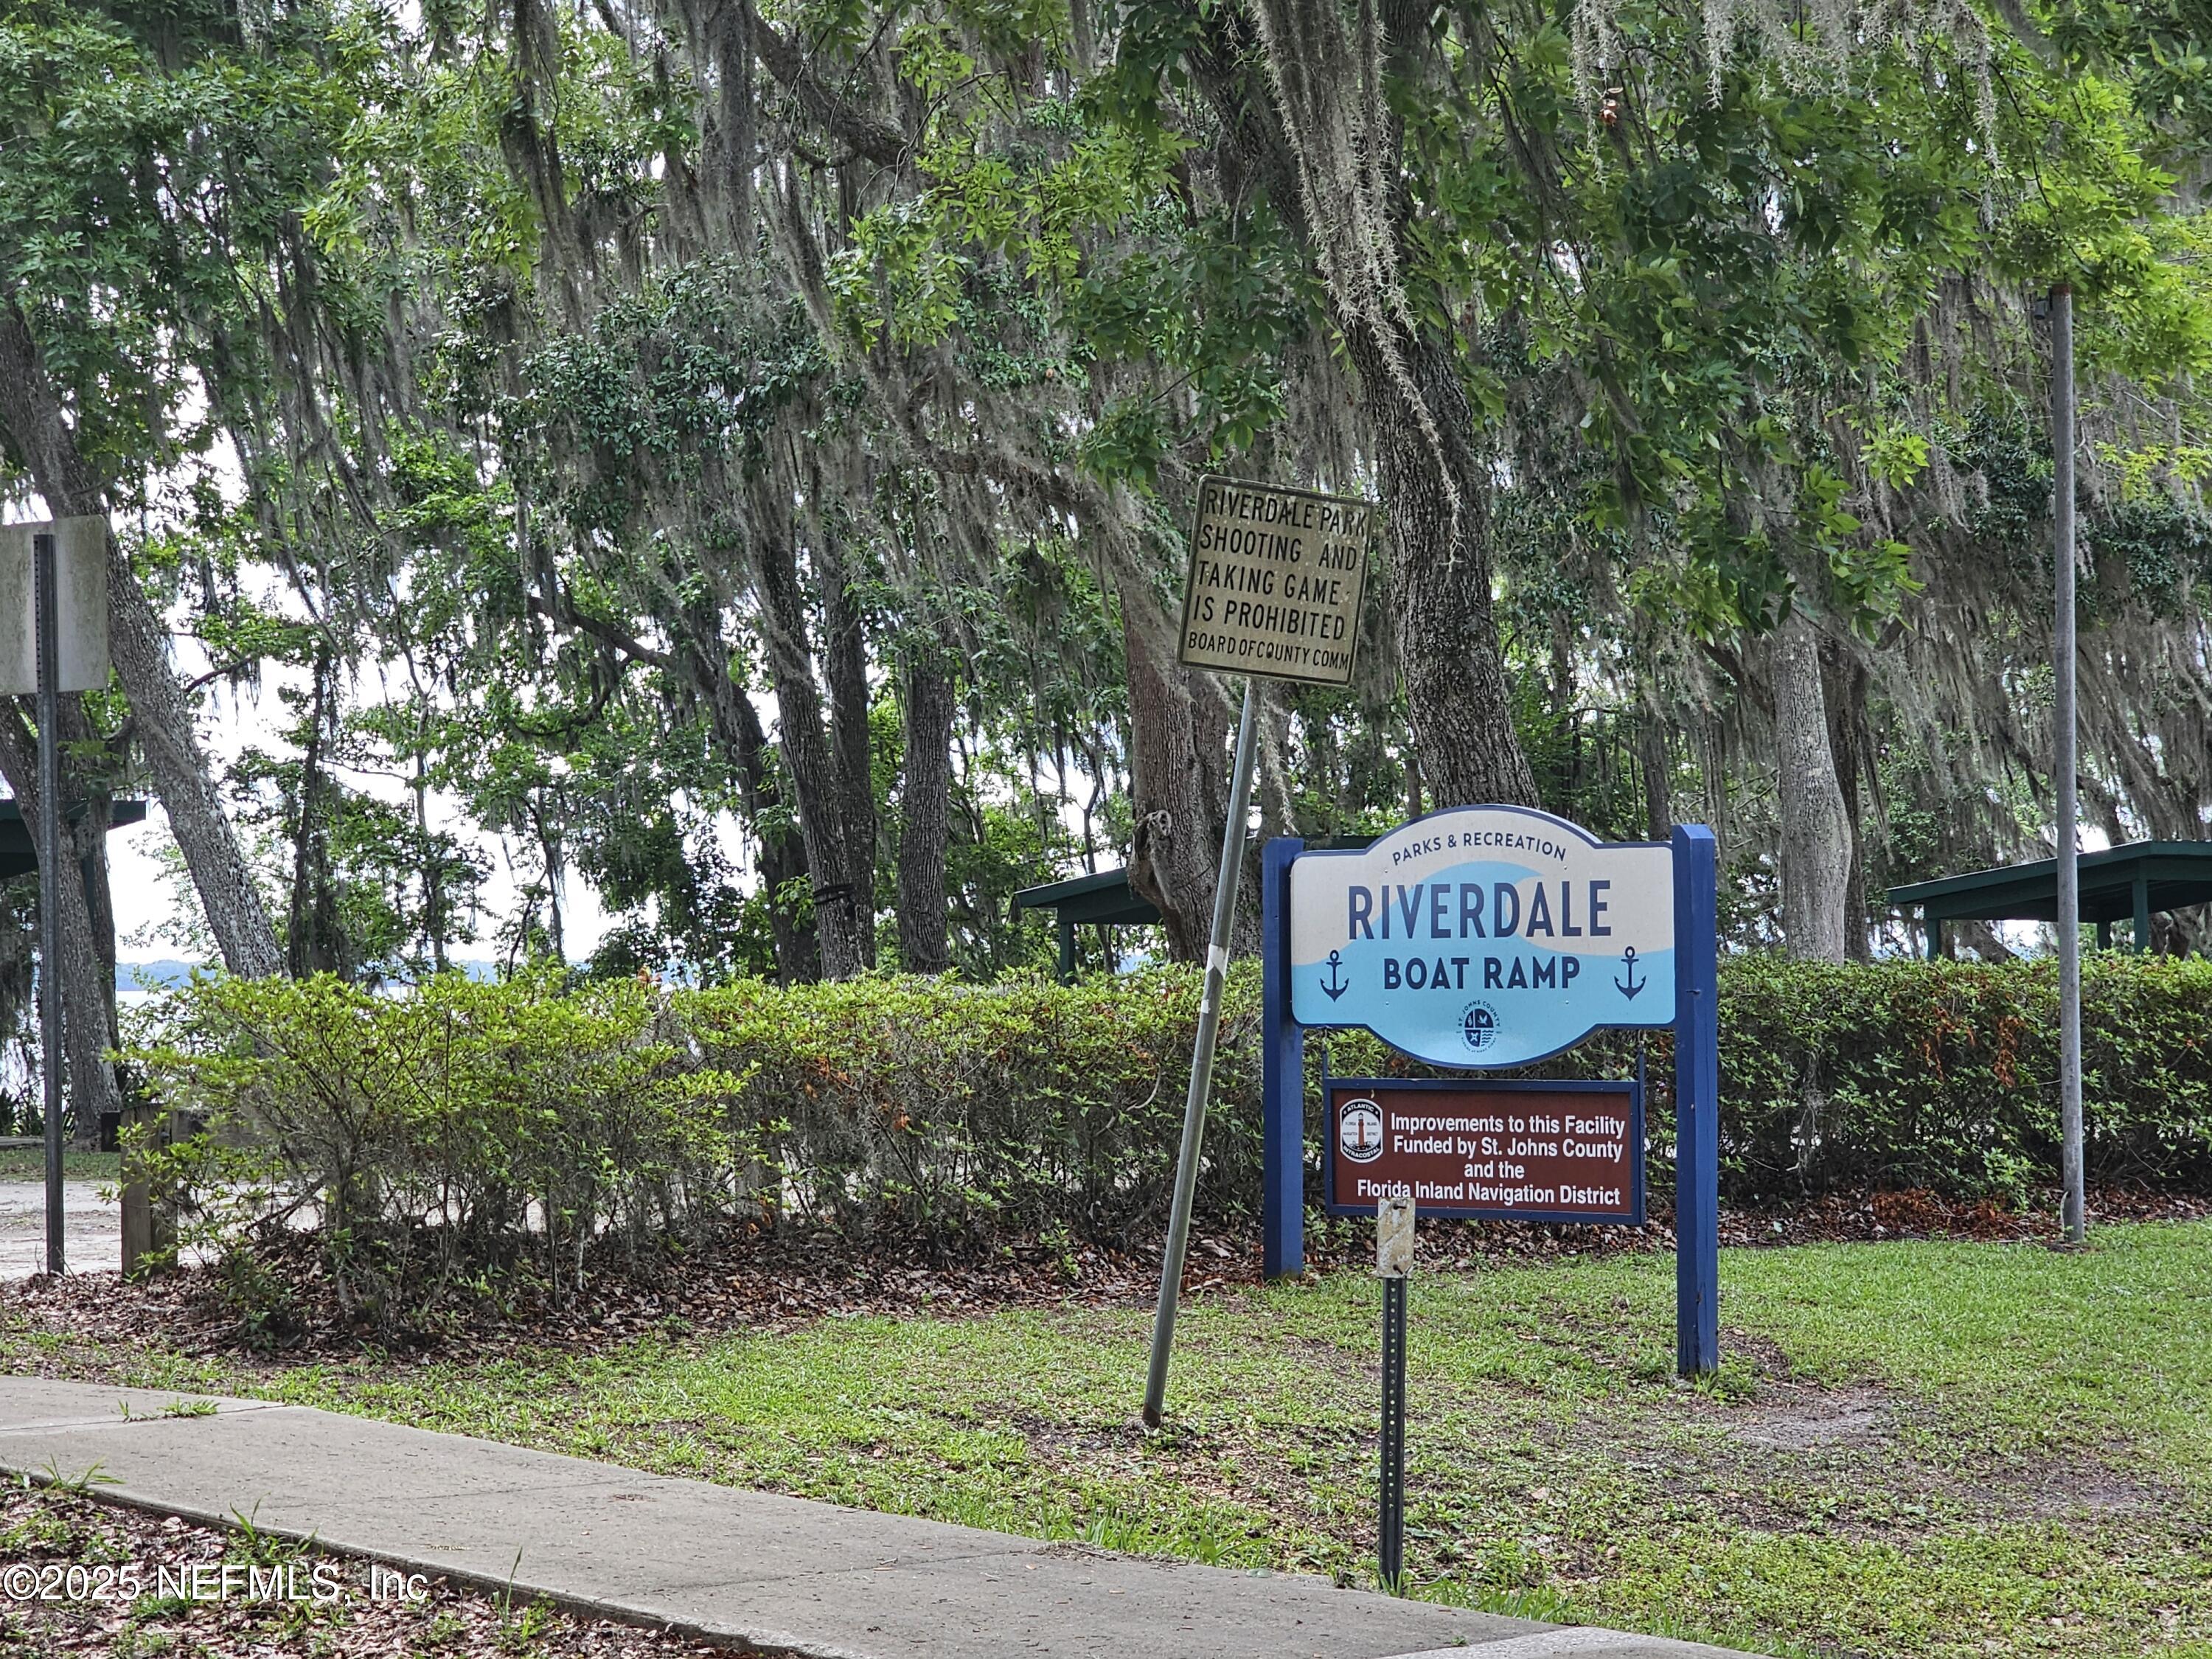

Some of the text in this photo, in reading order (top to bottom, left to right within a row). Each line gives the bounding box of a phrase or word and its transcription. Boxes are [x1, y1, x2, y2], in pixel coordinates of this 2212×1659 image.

[1205, 488, 1366, 536] RIVERDALE PARK
[1199, 524, 1357, 571] SHOOTING AND
[1197, 560, 1341, 605] TAKING GAME
[1193, 594, 1345, 640] IS PROHIBITED
[1189, 631, 1236, 654] BOARD
[1257, 641, 1310, 664] COUNTY
[1312, 649, 1349, 670] COMM
[1392, 832, 1567, 866] PARKS & RECREATION
[1349, 880, 1612, 940] RIVERDALE
[1384, 956, 1581, 990] BOAT RAMP
[1482, 1001, 1500, 1027] COUNTY
[1346, 1103, 1375, 1112] ATLANTIC
[1391, 1112, 1625, 1140] Improvements to this Facility
[1394, 1135, 1624, 1164] Funded by St. Johns County
[1464, 1160, 1525, 1179] and the
[1357, 1180, 1621, 1206] Florida Inland Navigation District
